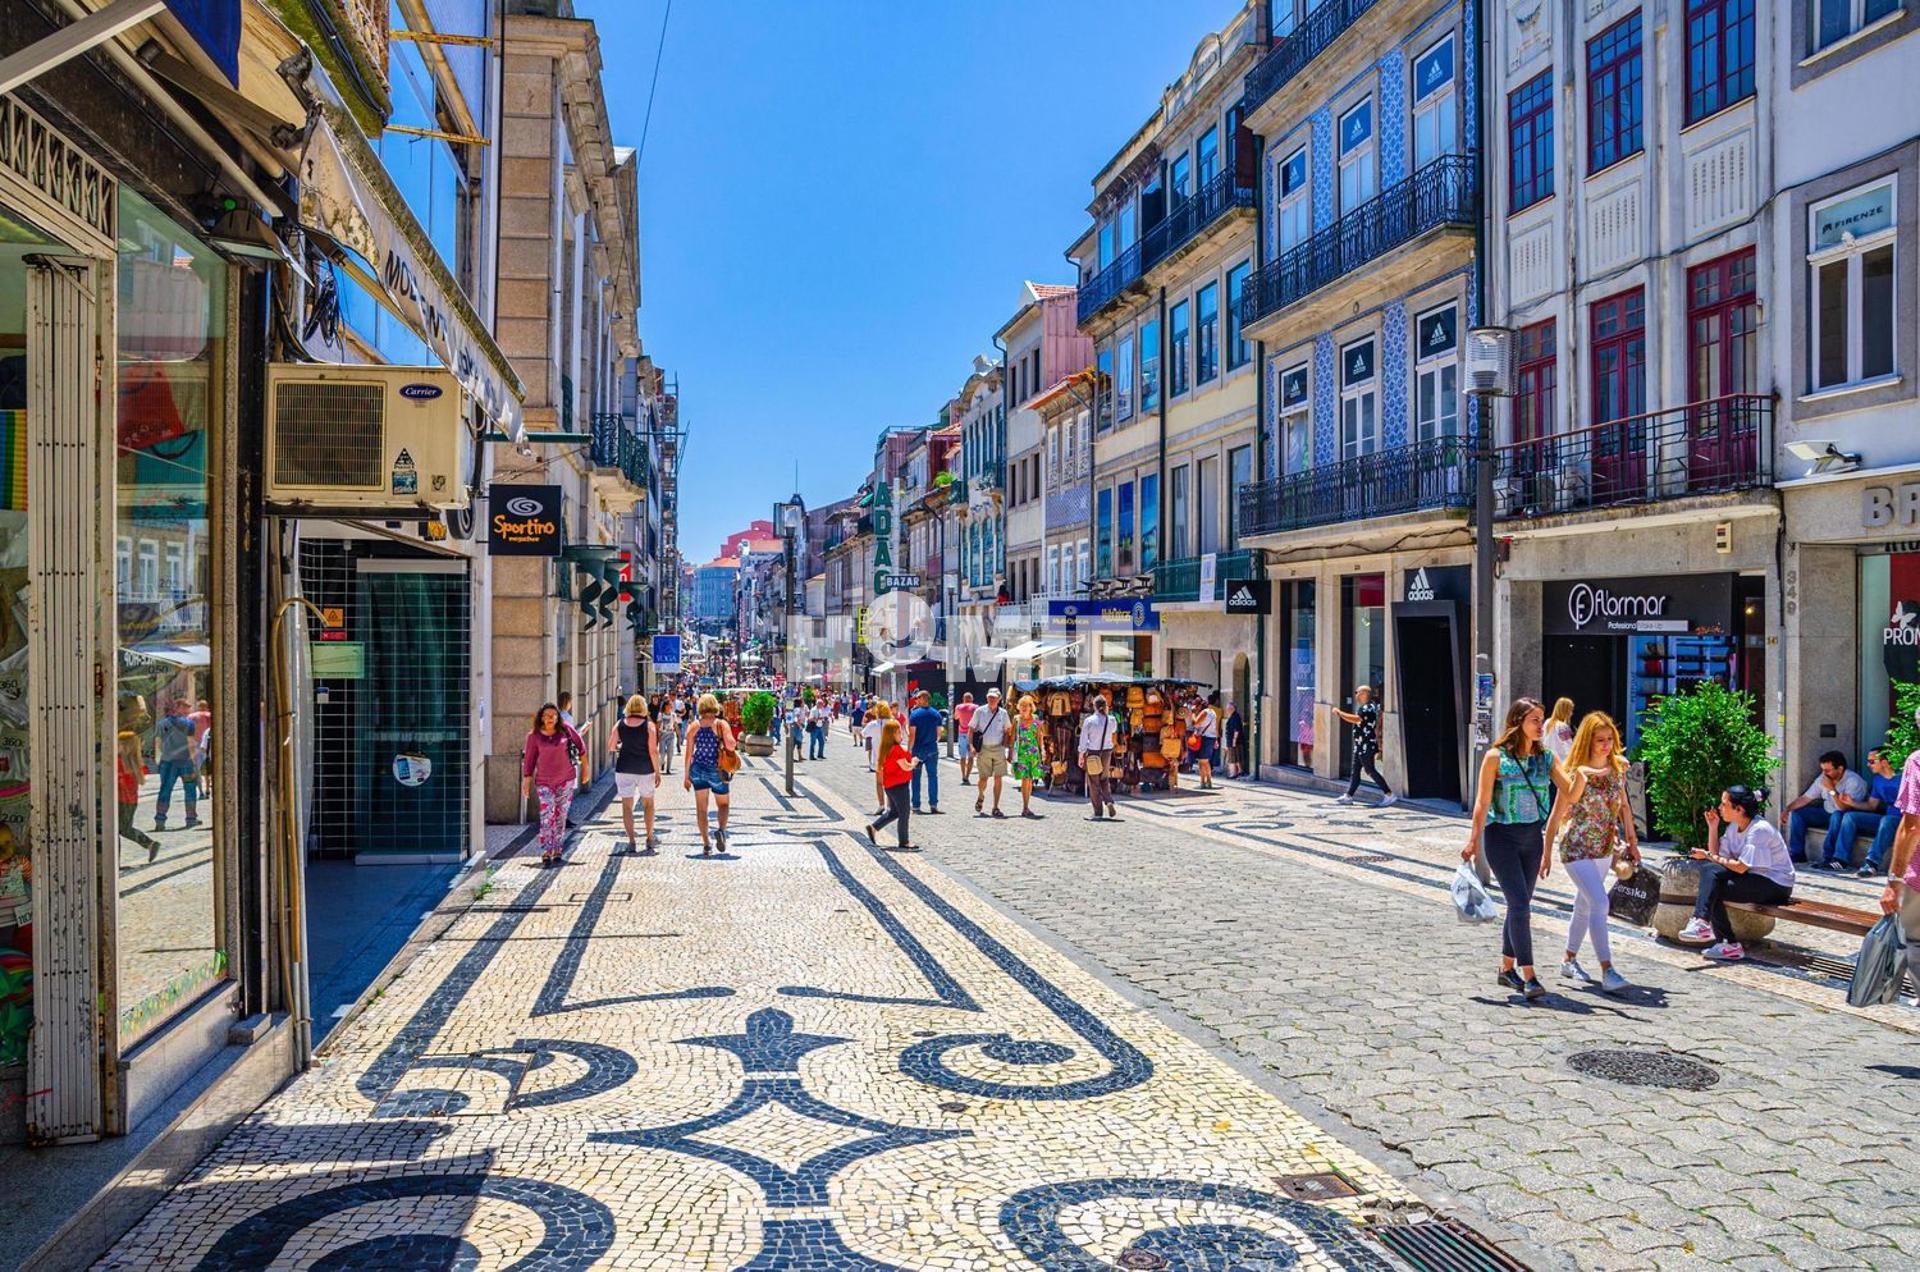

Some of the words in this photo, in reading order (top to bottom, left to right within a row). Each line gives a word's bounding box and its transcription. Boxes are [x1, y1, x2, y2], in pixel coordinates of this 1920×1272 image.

[1834, 205, 1884, 229] FIRENZE
[405, 387, 437, 396] Carrier
[494, 514, 555, 539] Sportino
[887, 577, 920, 587] BAZAR
[1408, 588, 1434, 601] adidas
[1228, 598, 1257, 606] adidas
[1595, 588, 1666, 616] flormar
